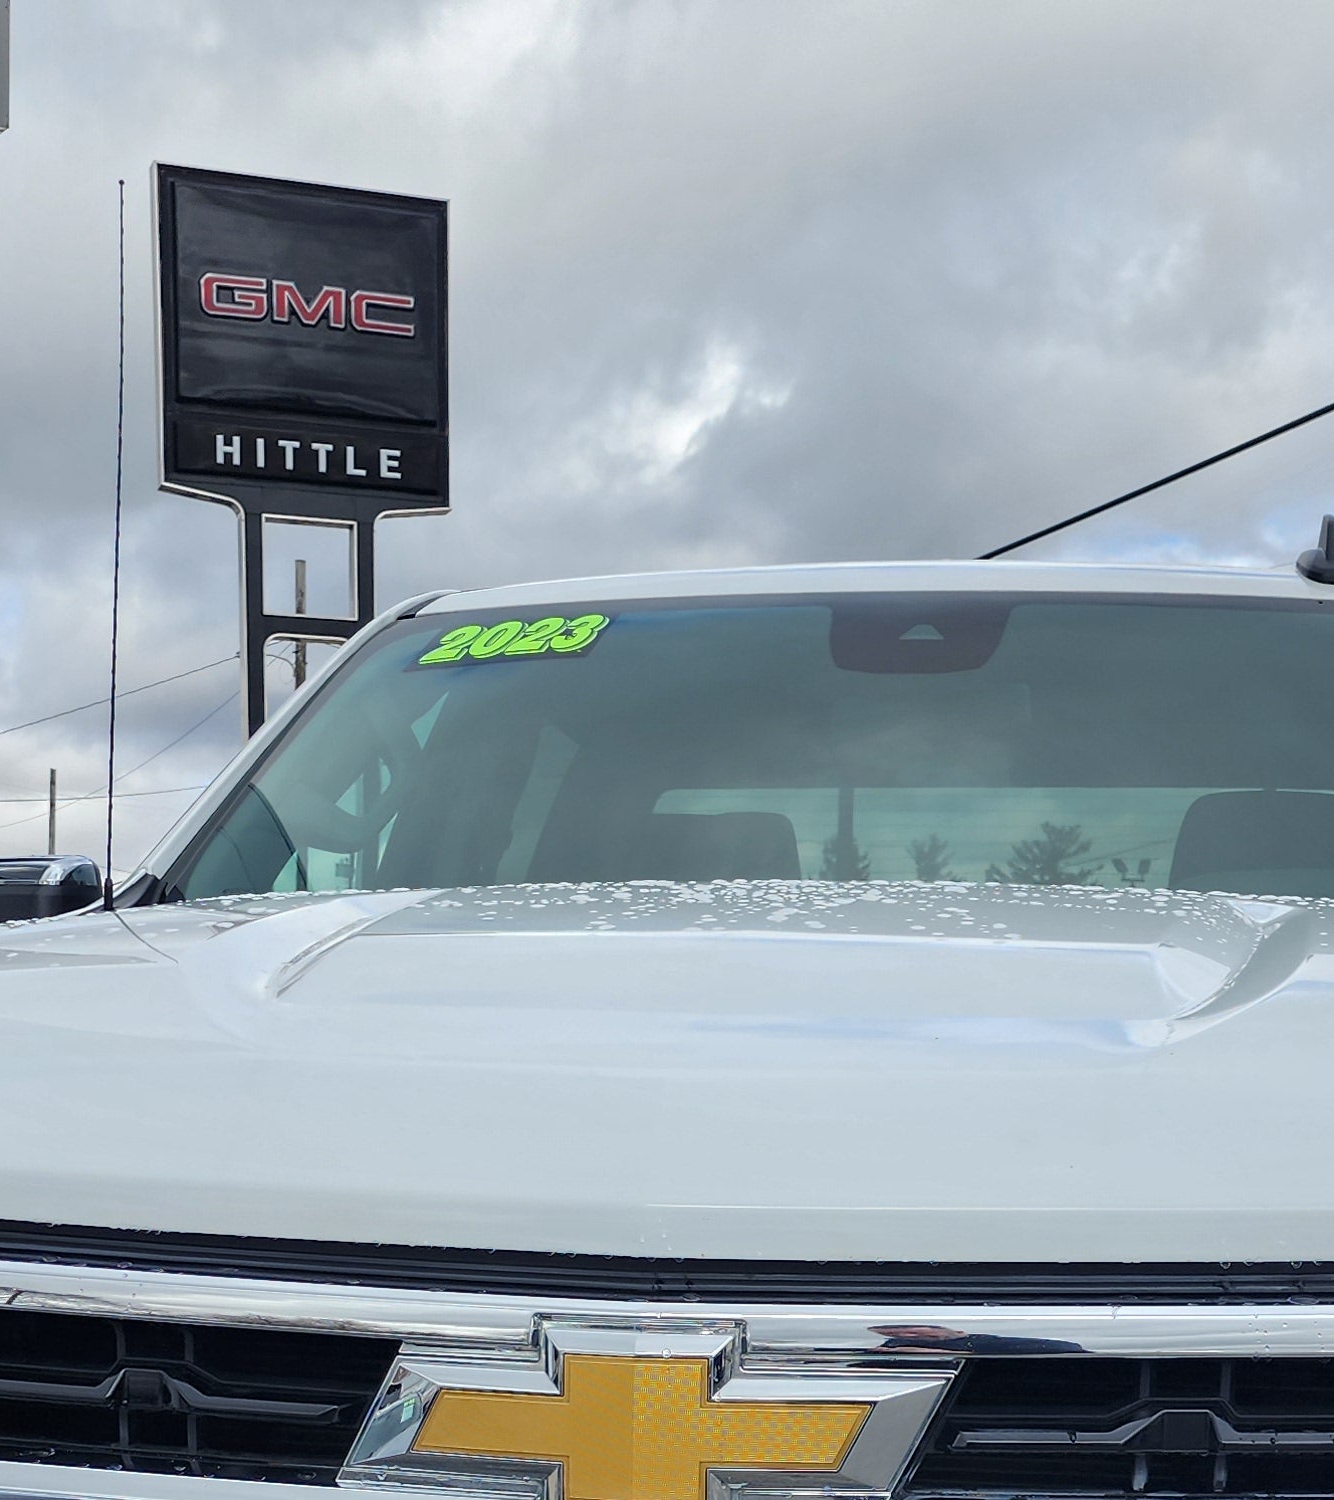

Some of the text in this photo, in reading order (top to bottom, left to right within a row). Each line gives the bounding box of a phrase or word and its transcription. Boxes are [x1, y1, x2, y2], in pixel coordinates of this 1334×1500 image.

[199, 272, 415, 337] GMC
[215, 434, 402, 479] HITTLE
[418, 614, 610, 664] 2023
